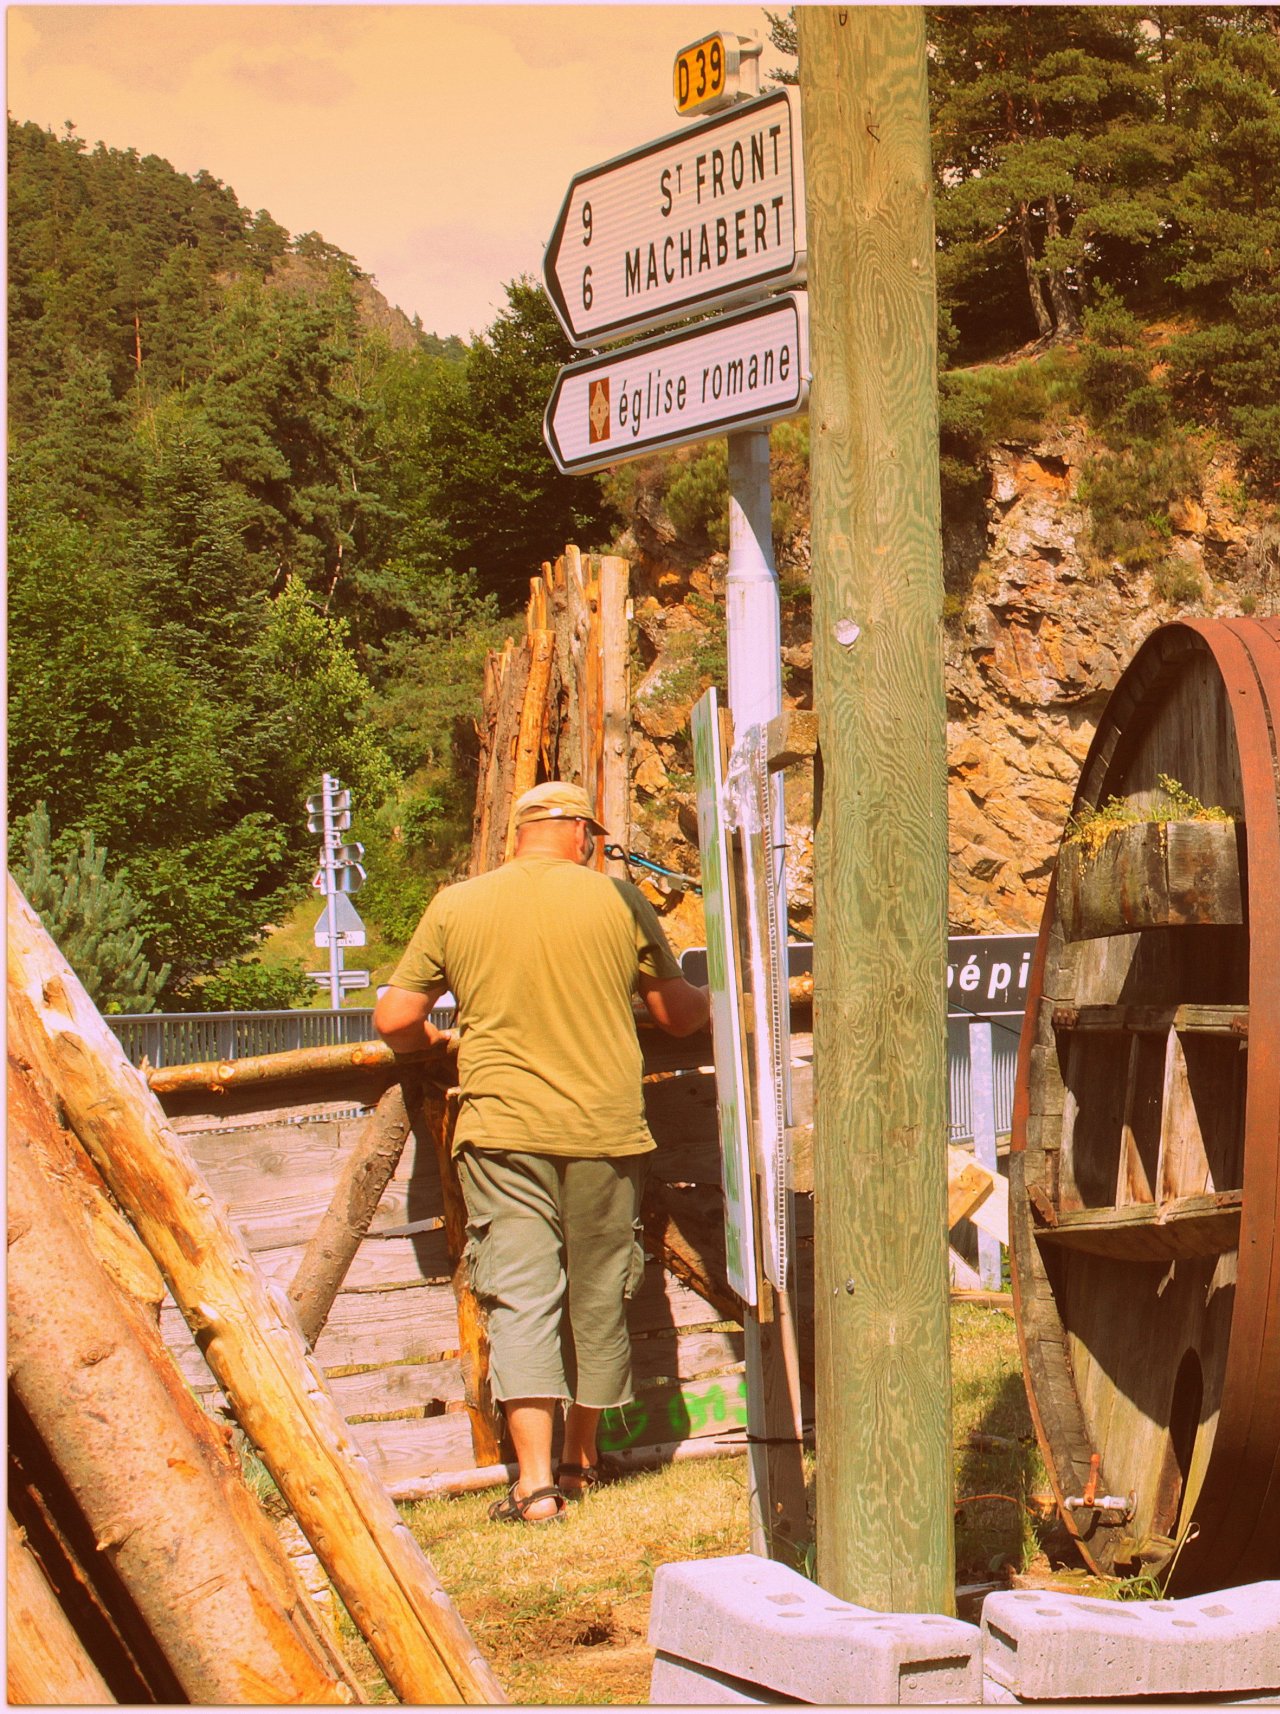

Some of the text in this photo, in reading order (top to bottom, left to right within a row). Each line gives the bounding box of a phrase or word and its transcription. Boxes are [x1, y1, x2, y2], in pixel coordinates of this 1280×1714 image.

[582, 201, 593, 247] 9
[696, 125, 781, 205] FRONT
[582, 196, 784, 311] 6 MACHABERT
[618, 344, 790, 437] église romane
